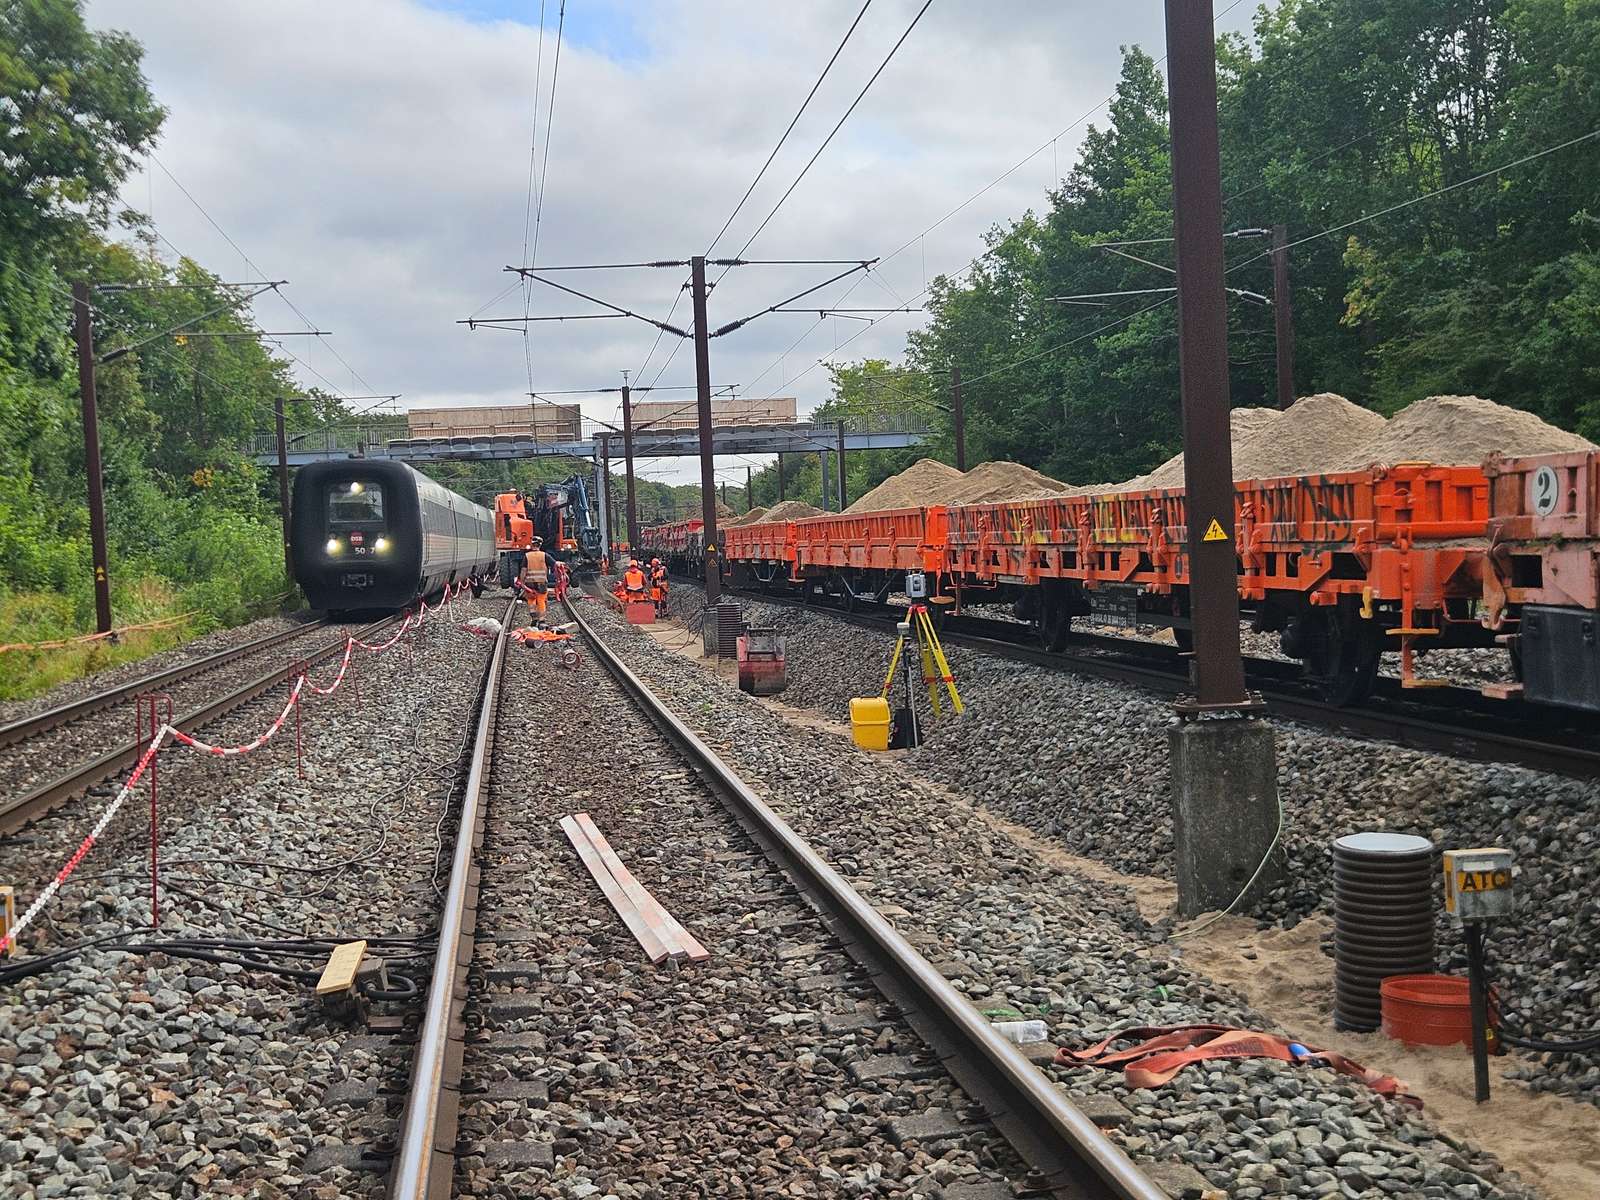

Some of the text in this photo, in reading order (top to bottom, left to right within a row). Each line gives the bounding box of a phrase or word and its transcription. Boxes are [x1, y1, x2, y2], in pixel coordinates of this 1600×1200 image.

[1537, 471, 1551, 508] 2
[354, 547, 366, 555] 50
[1462, 869, 1506, 891] ATC
